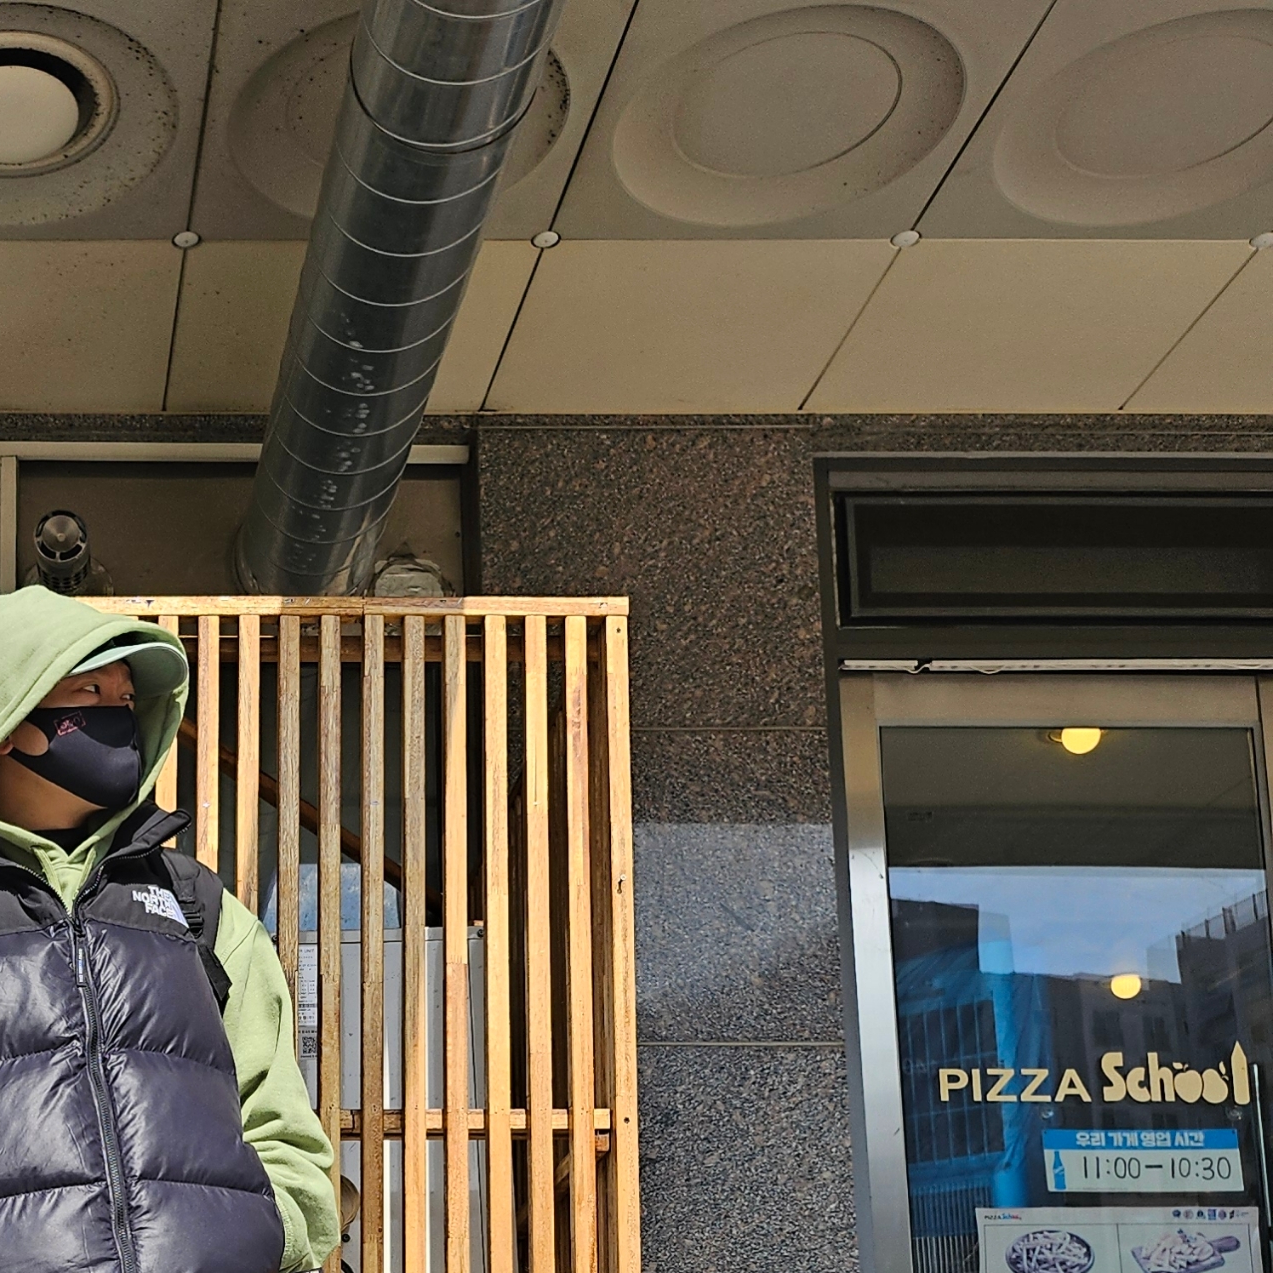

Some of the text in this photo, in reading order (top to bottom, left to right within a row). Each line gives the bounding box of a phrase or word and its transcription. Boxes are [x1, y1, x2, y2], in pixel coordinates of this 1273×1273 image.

[132, 890, 173, 909] NORTH
[148, 885, 171, 899] THE
[145, 901, 175, 917] FACE
[938, 1040, 1250, 1105] PIZZA School
[1075, 1131, 1205, 1147] 우리 가게 영업 시간
